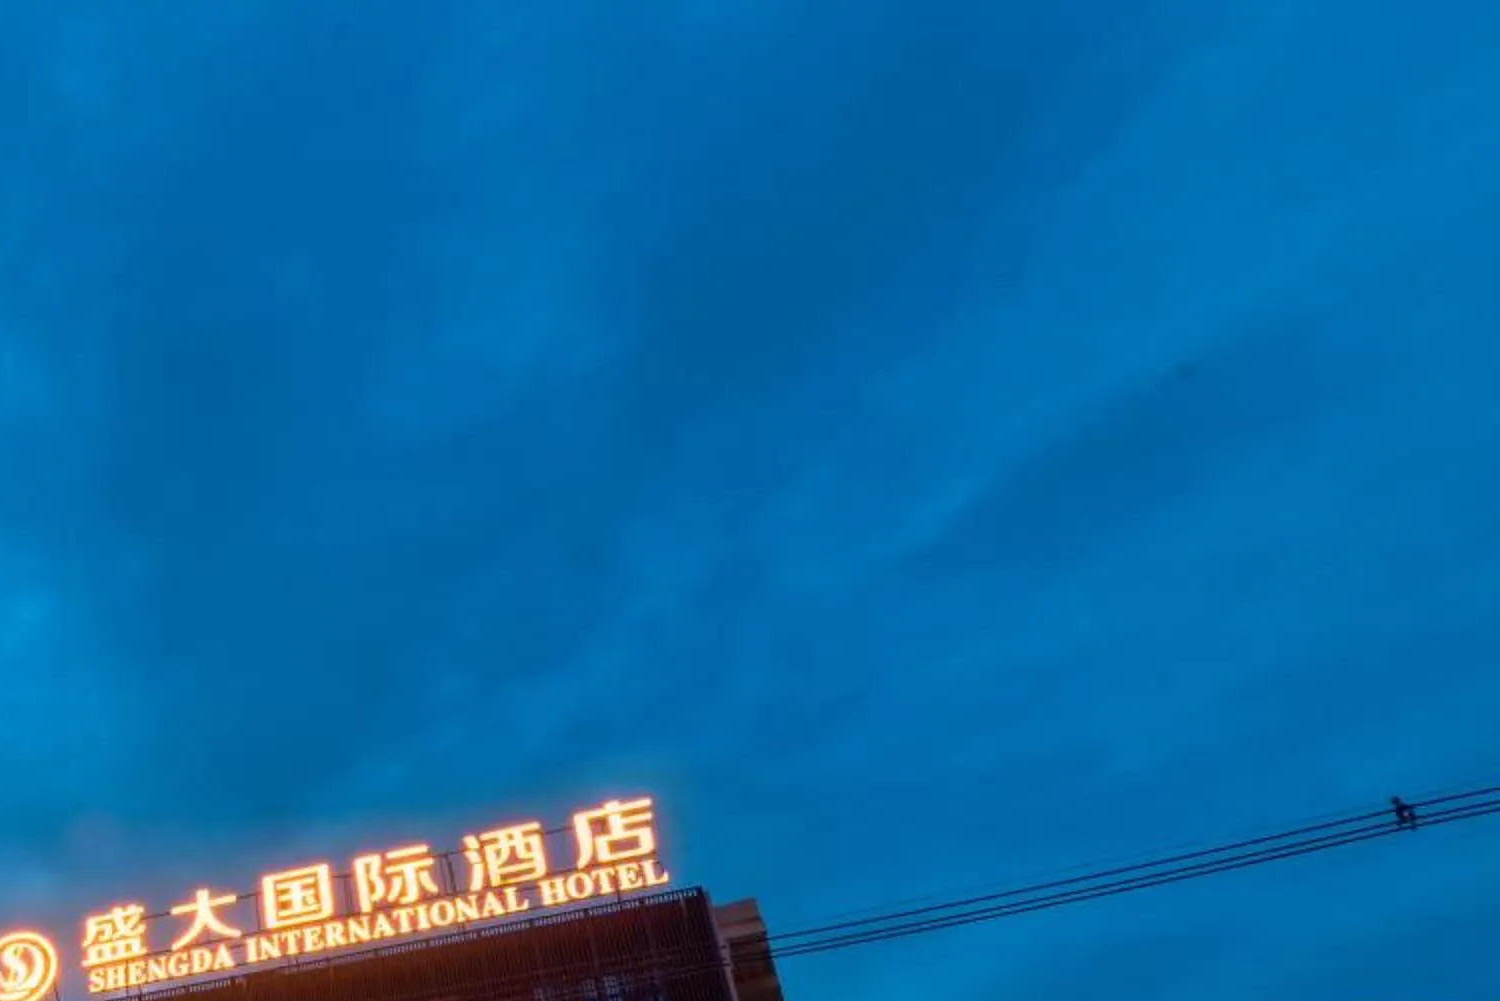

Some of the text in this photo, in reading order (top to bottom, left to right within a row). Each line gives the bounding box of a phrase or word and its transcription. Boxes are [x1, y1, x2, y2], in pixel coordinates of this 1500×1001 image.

[81, 797, 655, 968] 盛大国际酒店
[87, 857, 670, 994] SHENGDA INTERNATIONAL HOTEL
